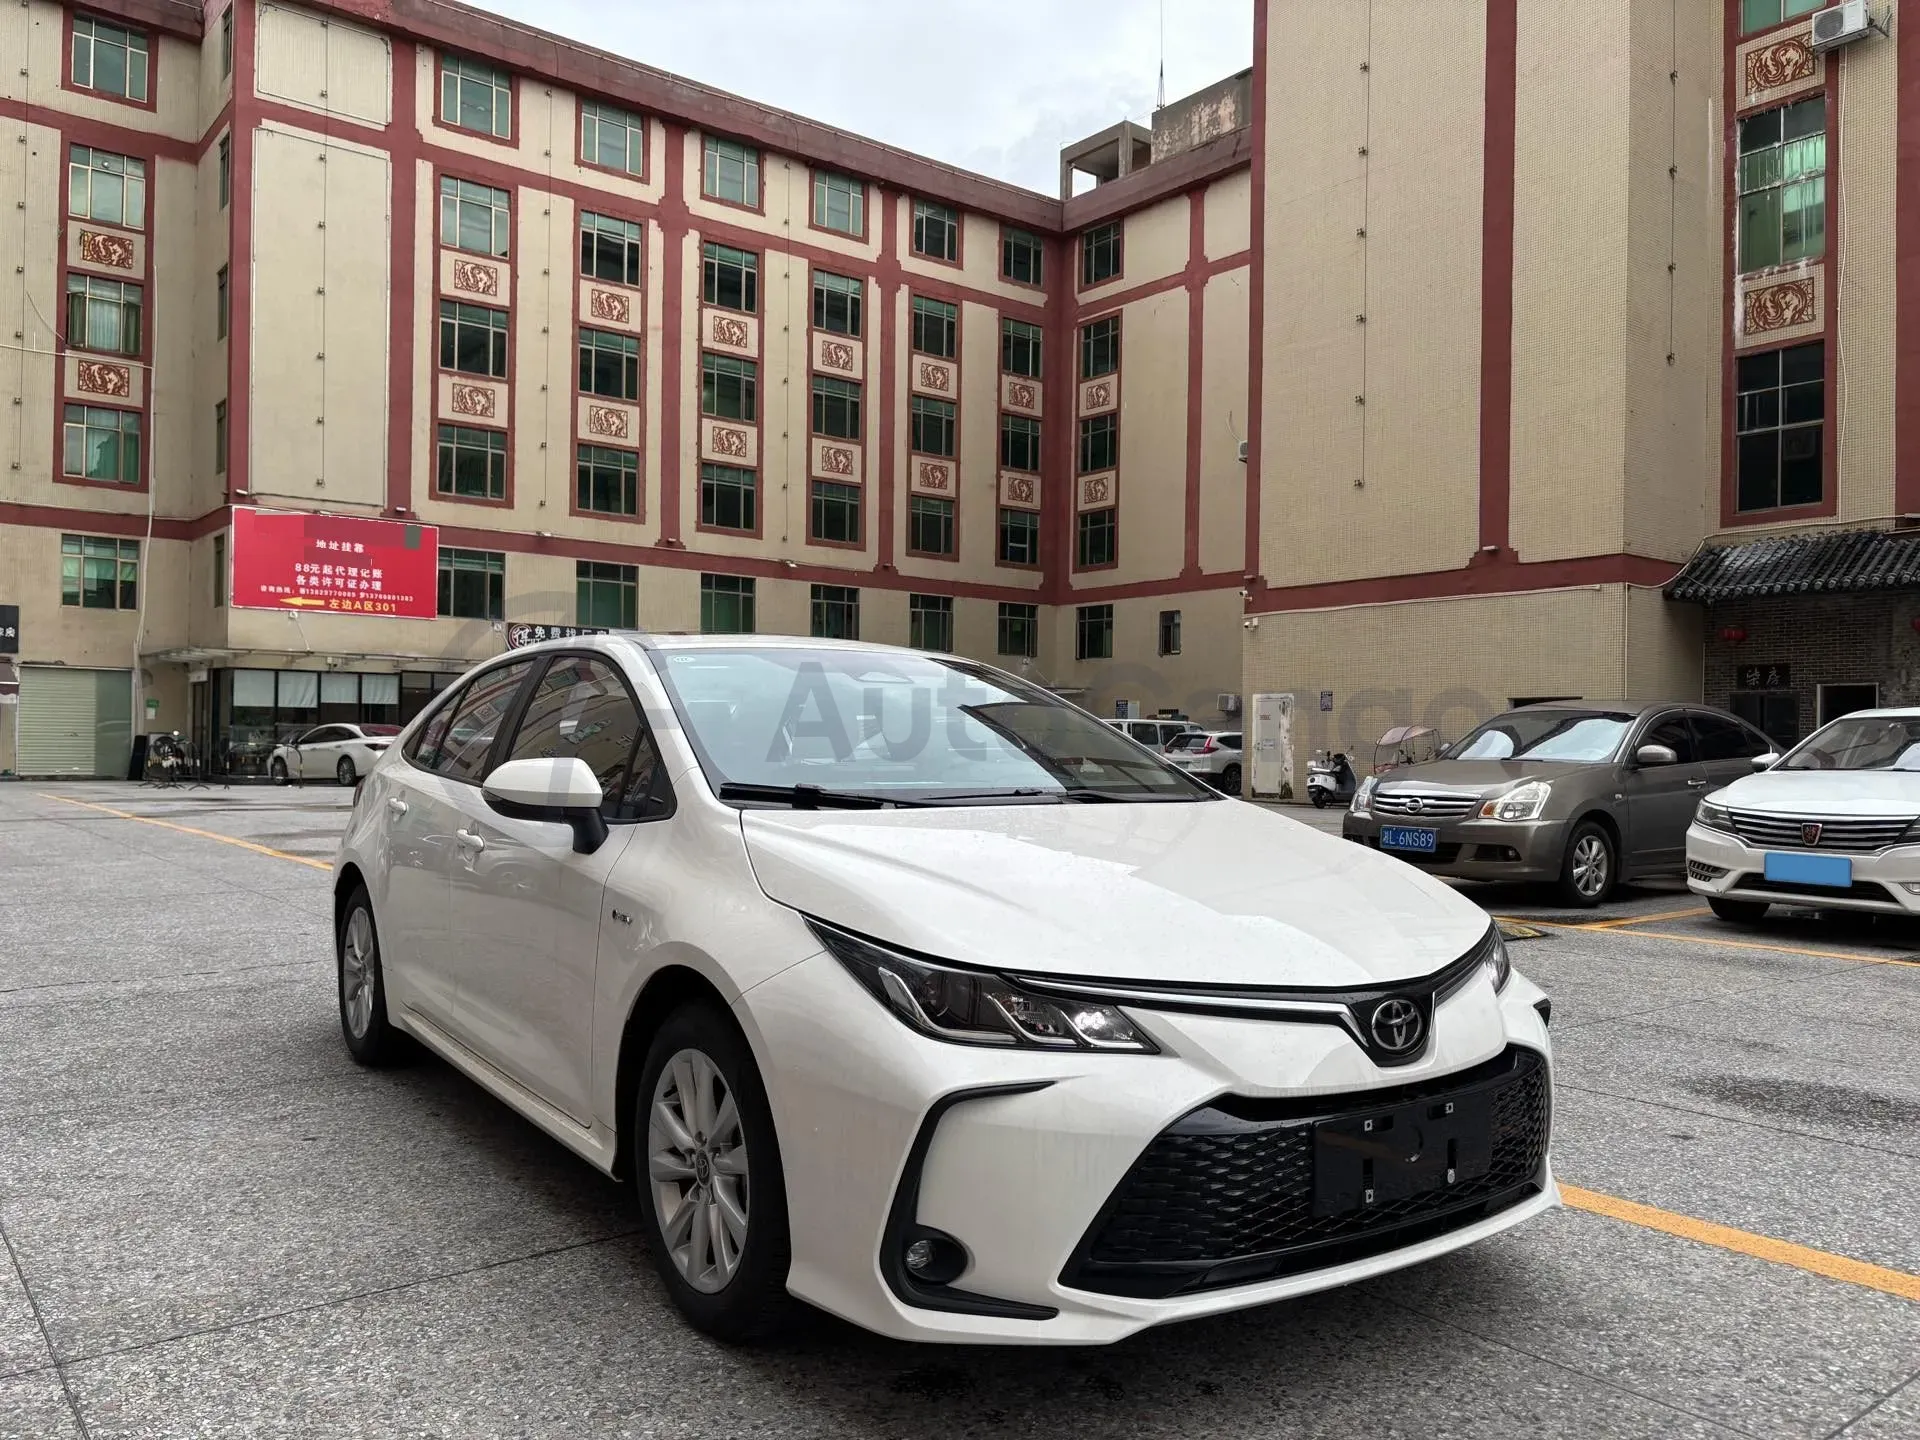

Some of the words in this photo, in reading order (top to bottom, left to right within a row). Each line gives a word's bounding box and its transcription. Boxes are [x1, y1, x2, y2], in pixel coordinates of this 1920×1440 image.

[316, 539, 364, 553] 地址挂靠
[295, 563, 383, 579] 88元起代理记账
[296, 575, 382, 591] 各类许可证办理
[329, 599, 396, 612] 左边A区301
